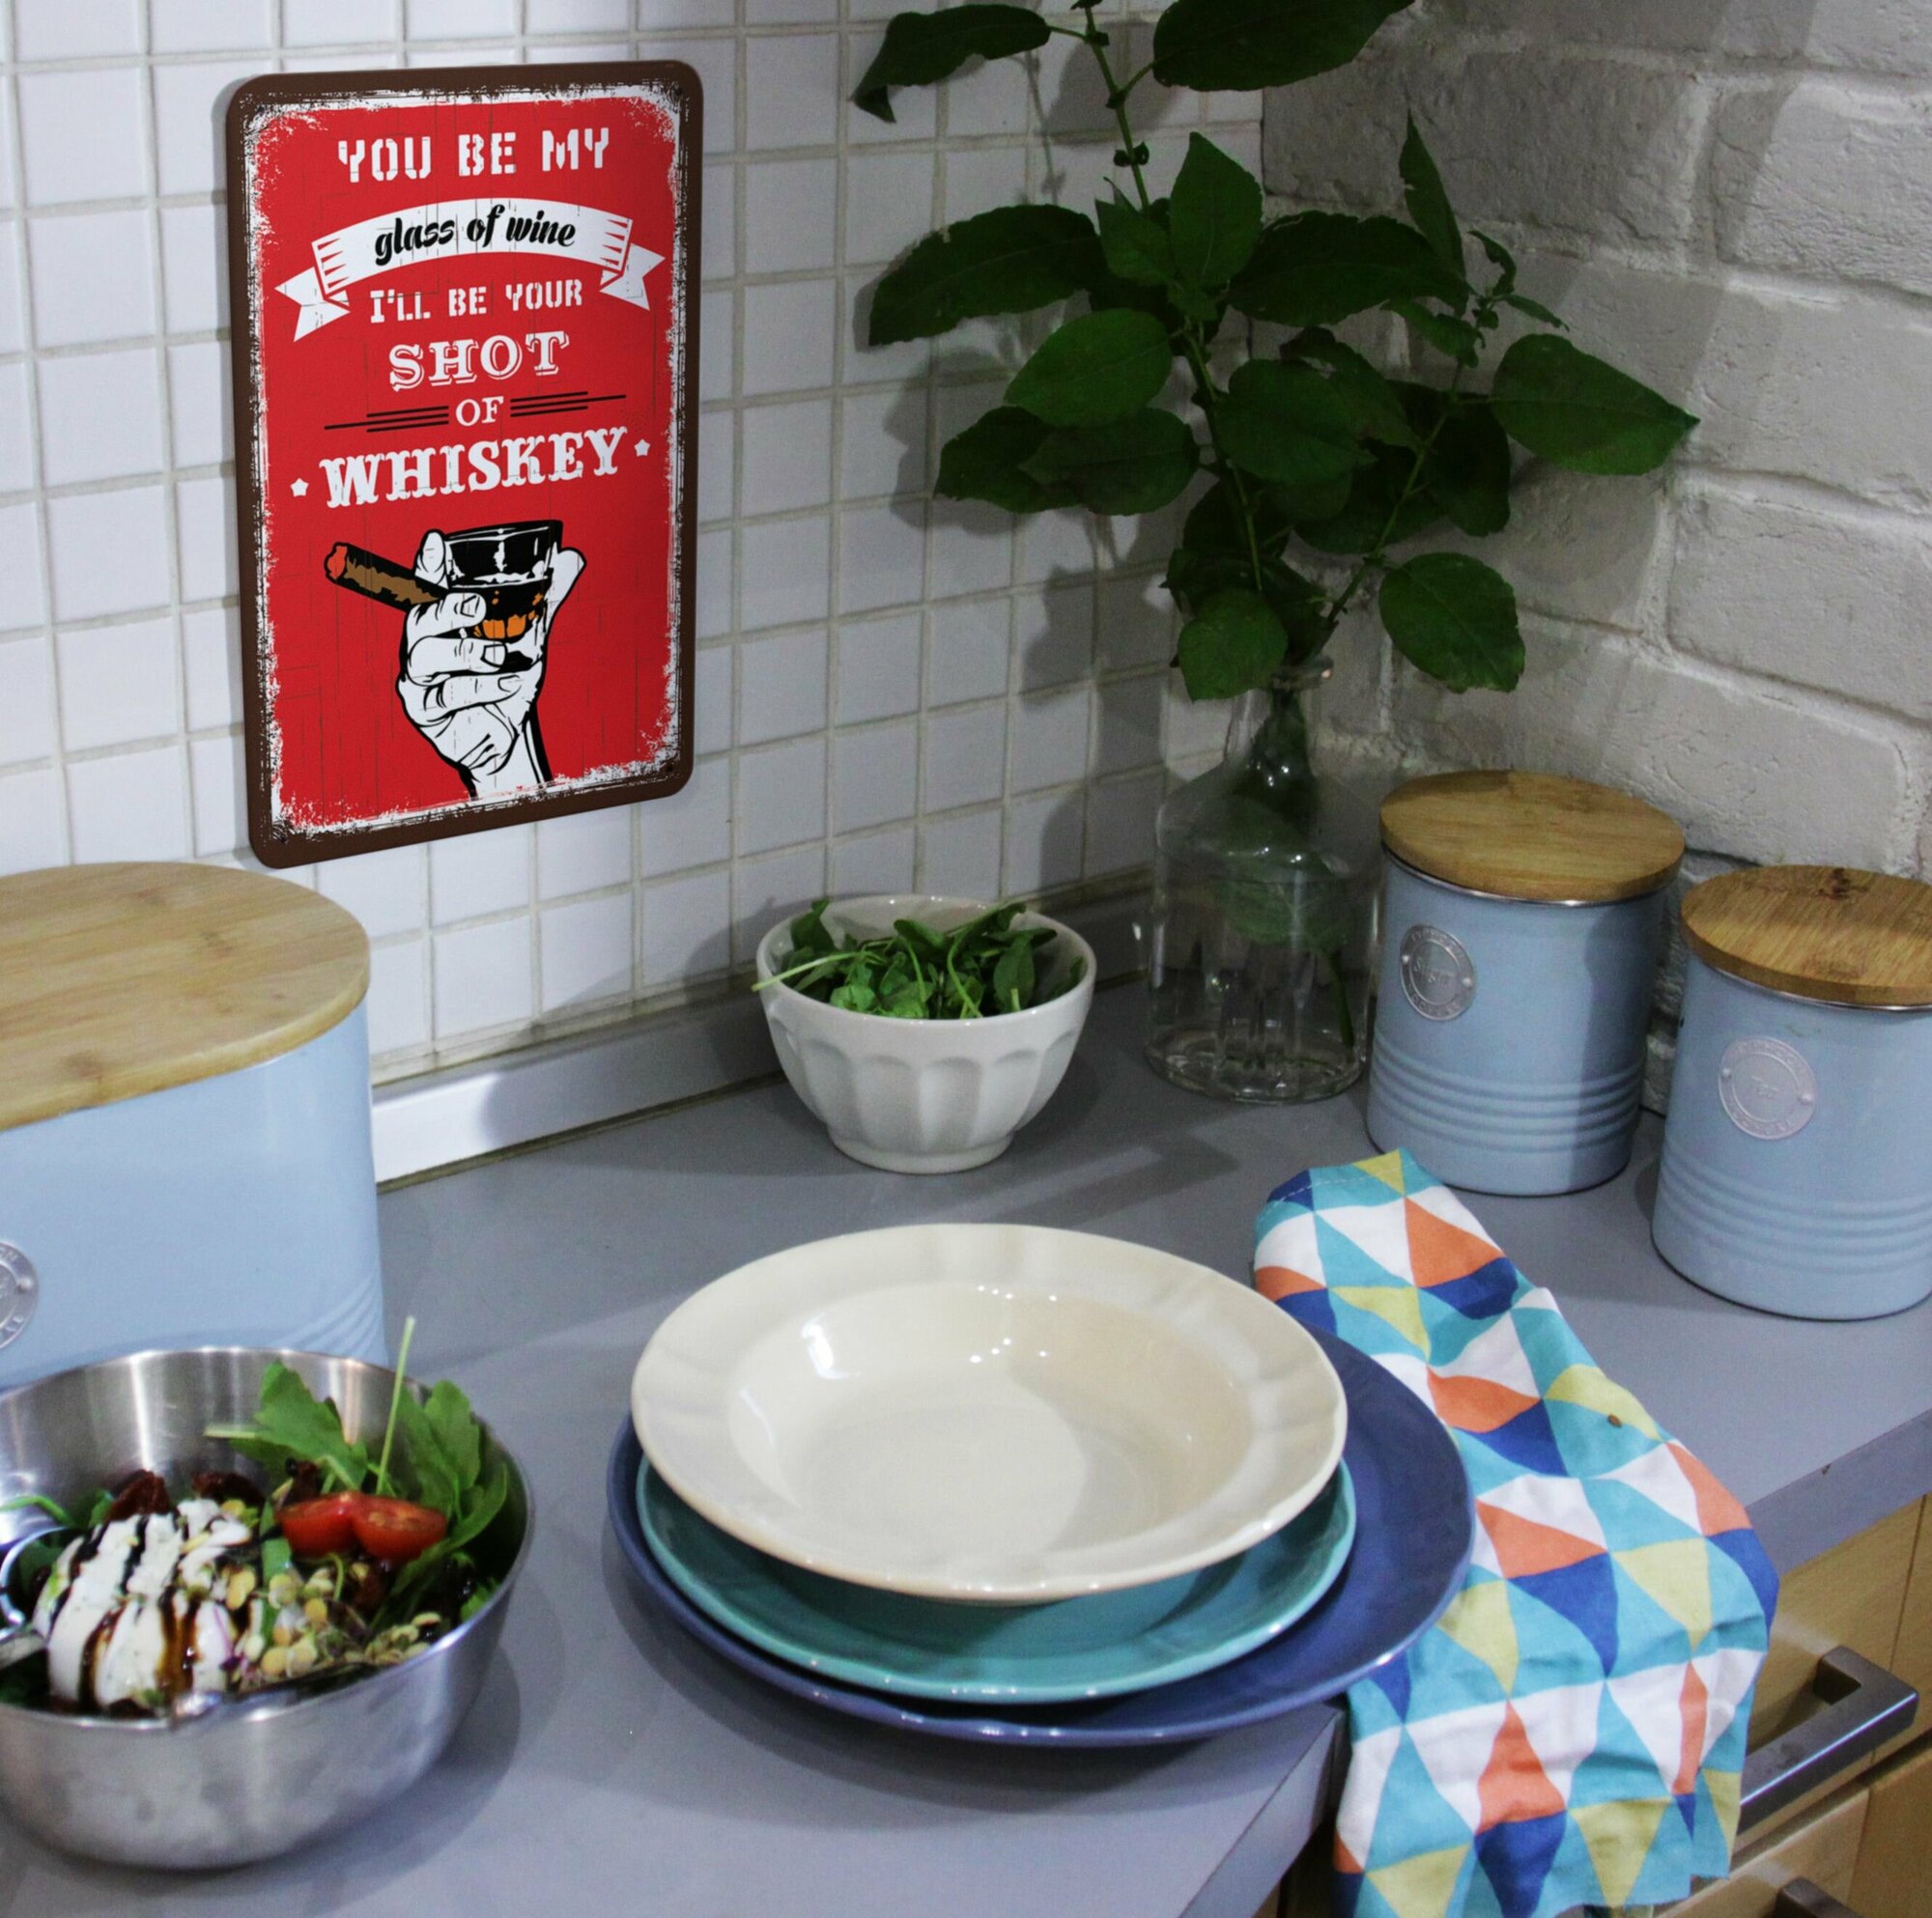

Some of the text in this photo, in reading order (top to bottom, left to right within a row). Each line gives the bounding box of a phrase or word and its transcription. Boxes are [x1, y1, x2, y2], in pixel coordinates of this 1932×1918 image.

[338, 127, 609, 183] YOU BE MY
[376, 205, 575, 266] glass of wine
[370, 279, 582, 323] I'LL BE YOUR
[389, 331, 569, 391] SHOT
[456, 396, 503, 426] OF
[319, 427, 627, 508] WHISKEY
